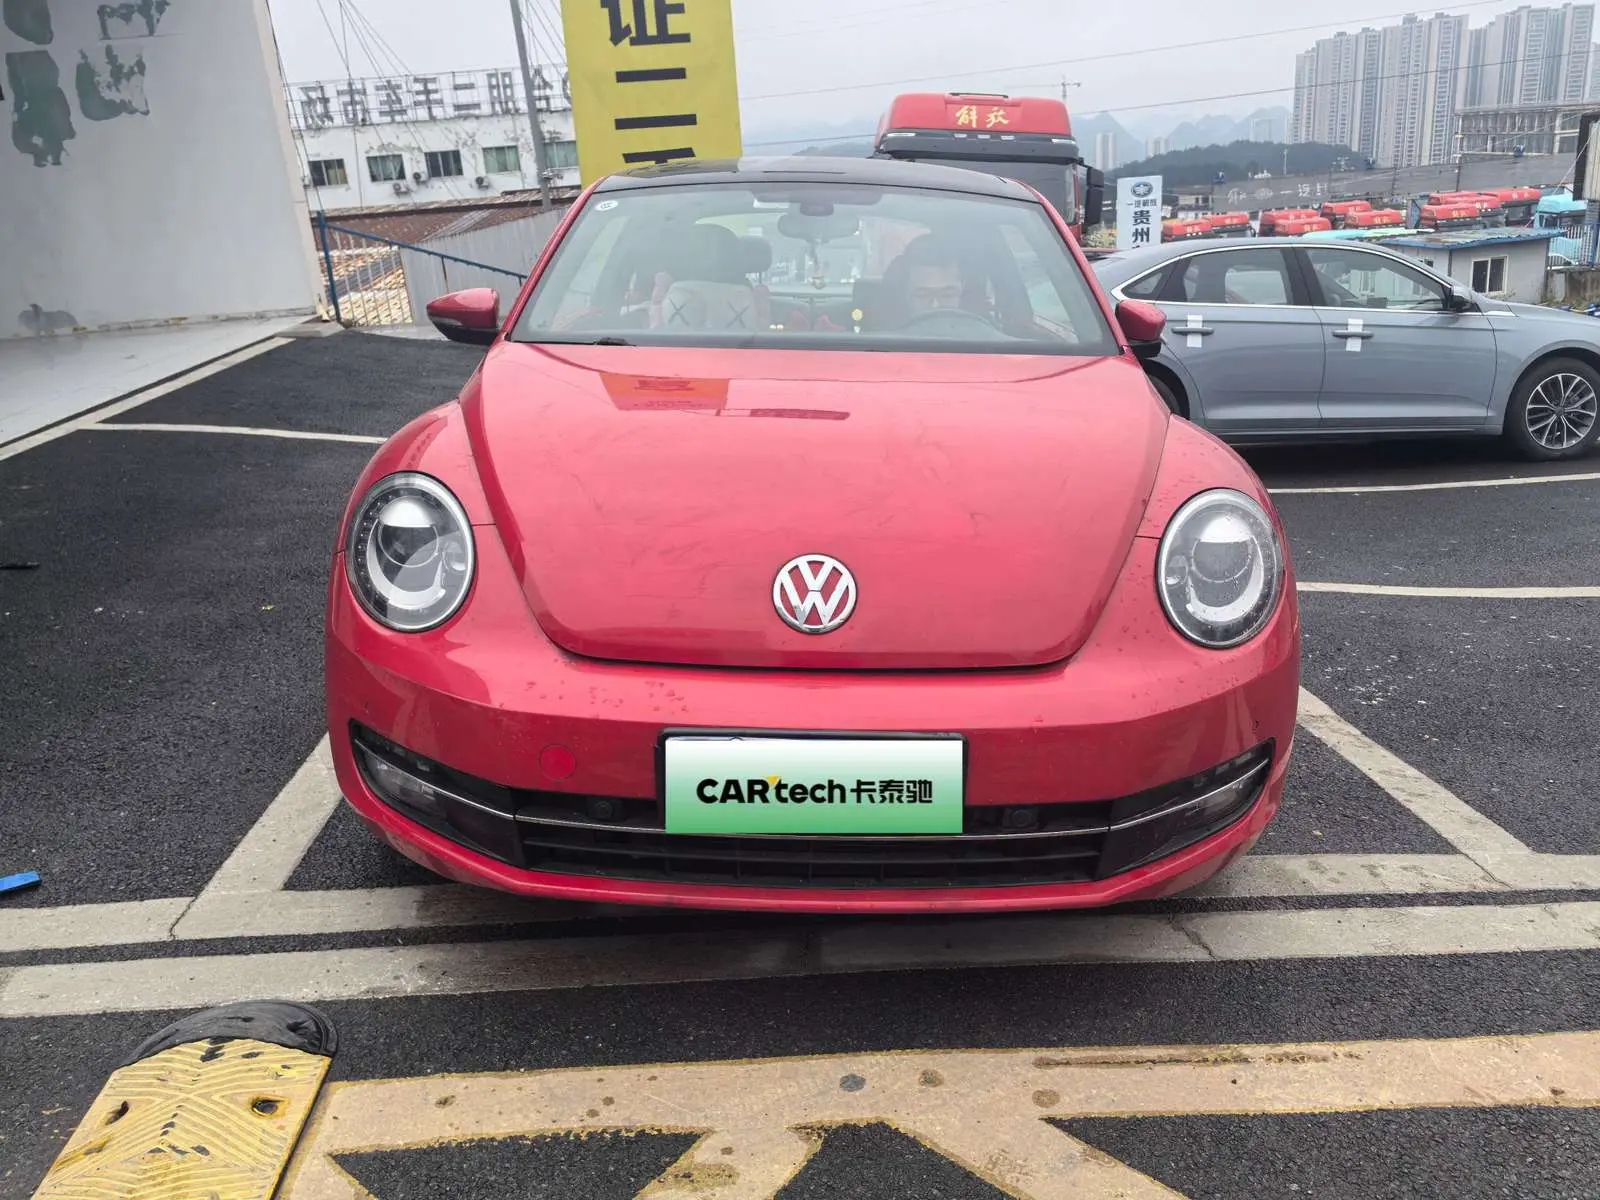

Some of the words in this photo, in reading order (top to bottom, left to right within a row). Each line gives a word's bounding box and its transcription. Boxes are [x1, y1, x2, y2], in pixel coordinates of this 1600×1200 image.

[600, 0, 697, 164] 证二
[955, 105, 1010, 128] 解放
[1132, 210, 1152, 249] 贵州
[773, 553, 857, 634] VW
